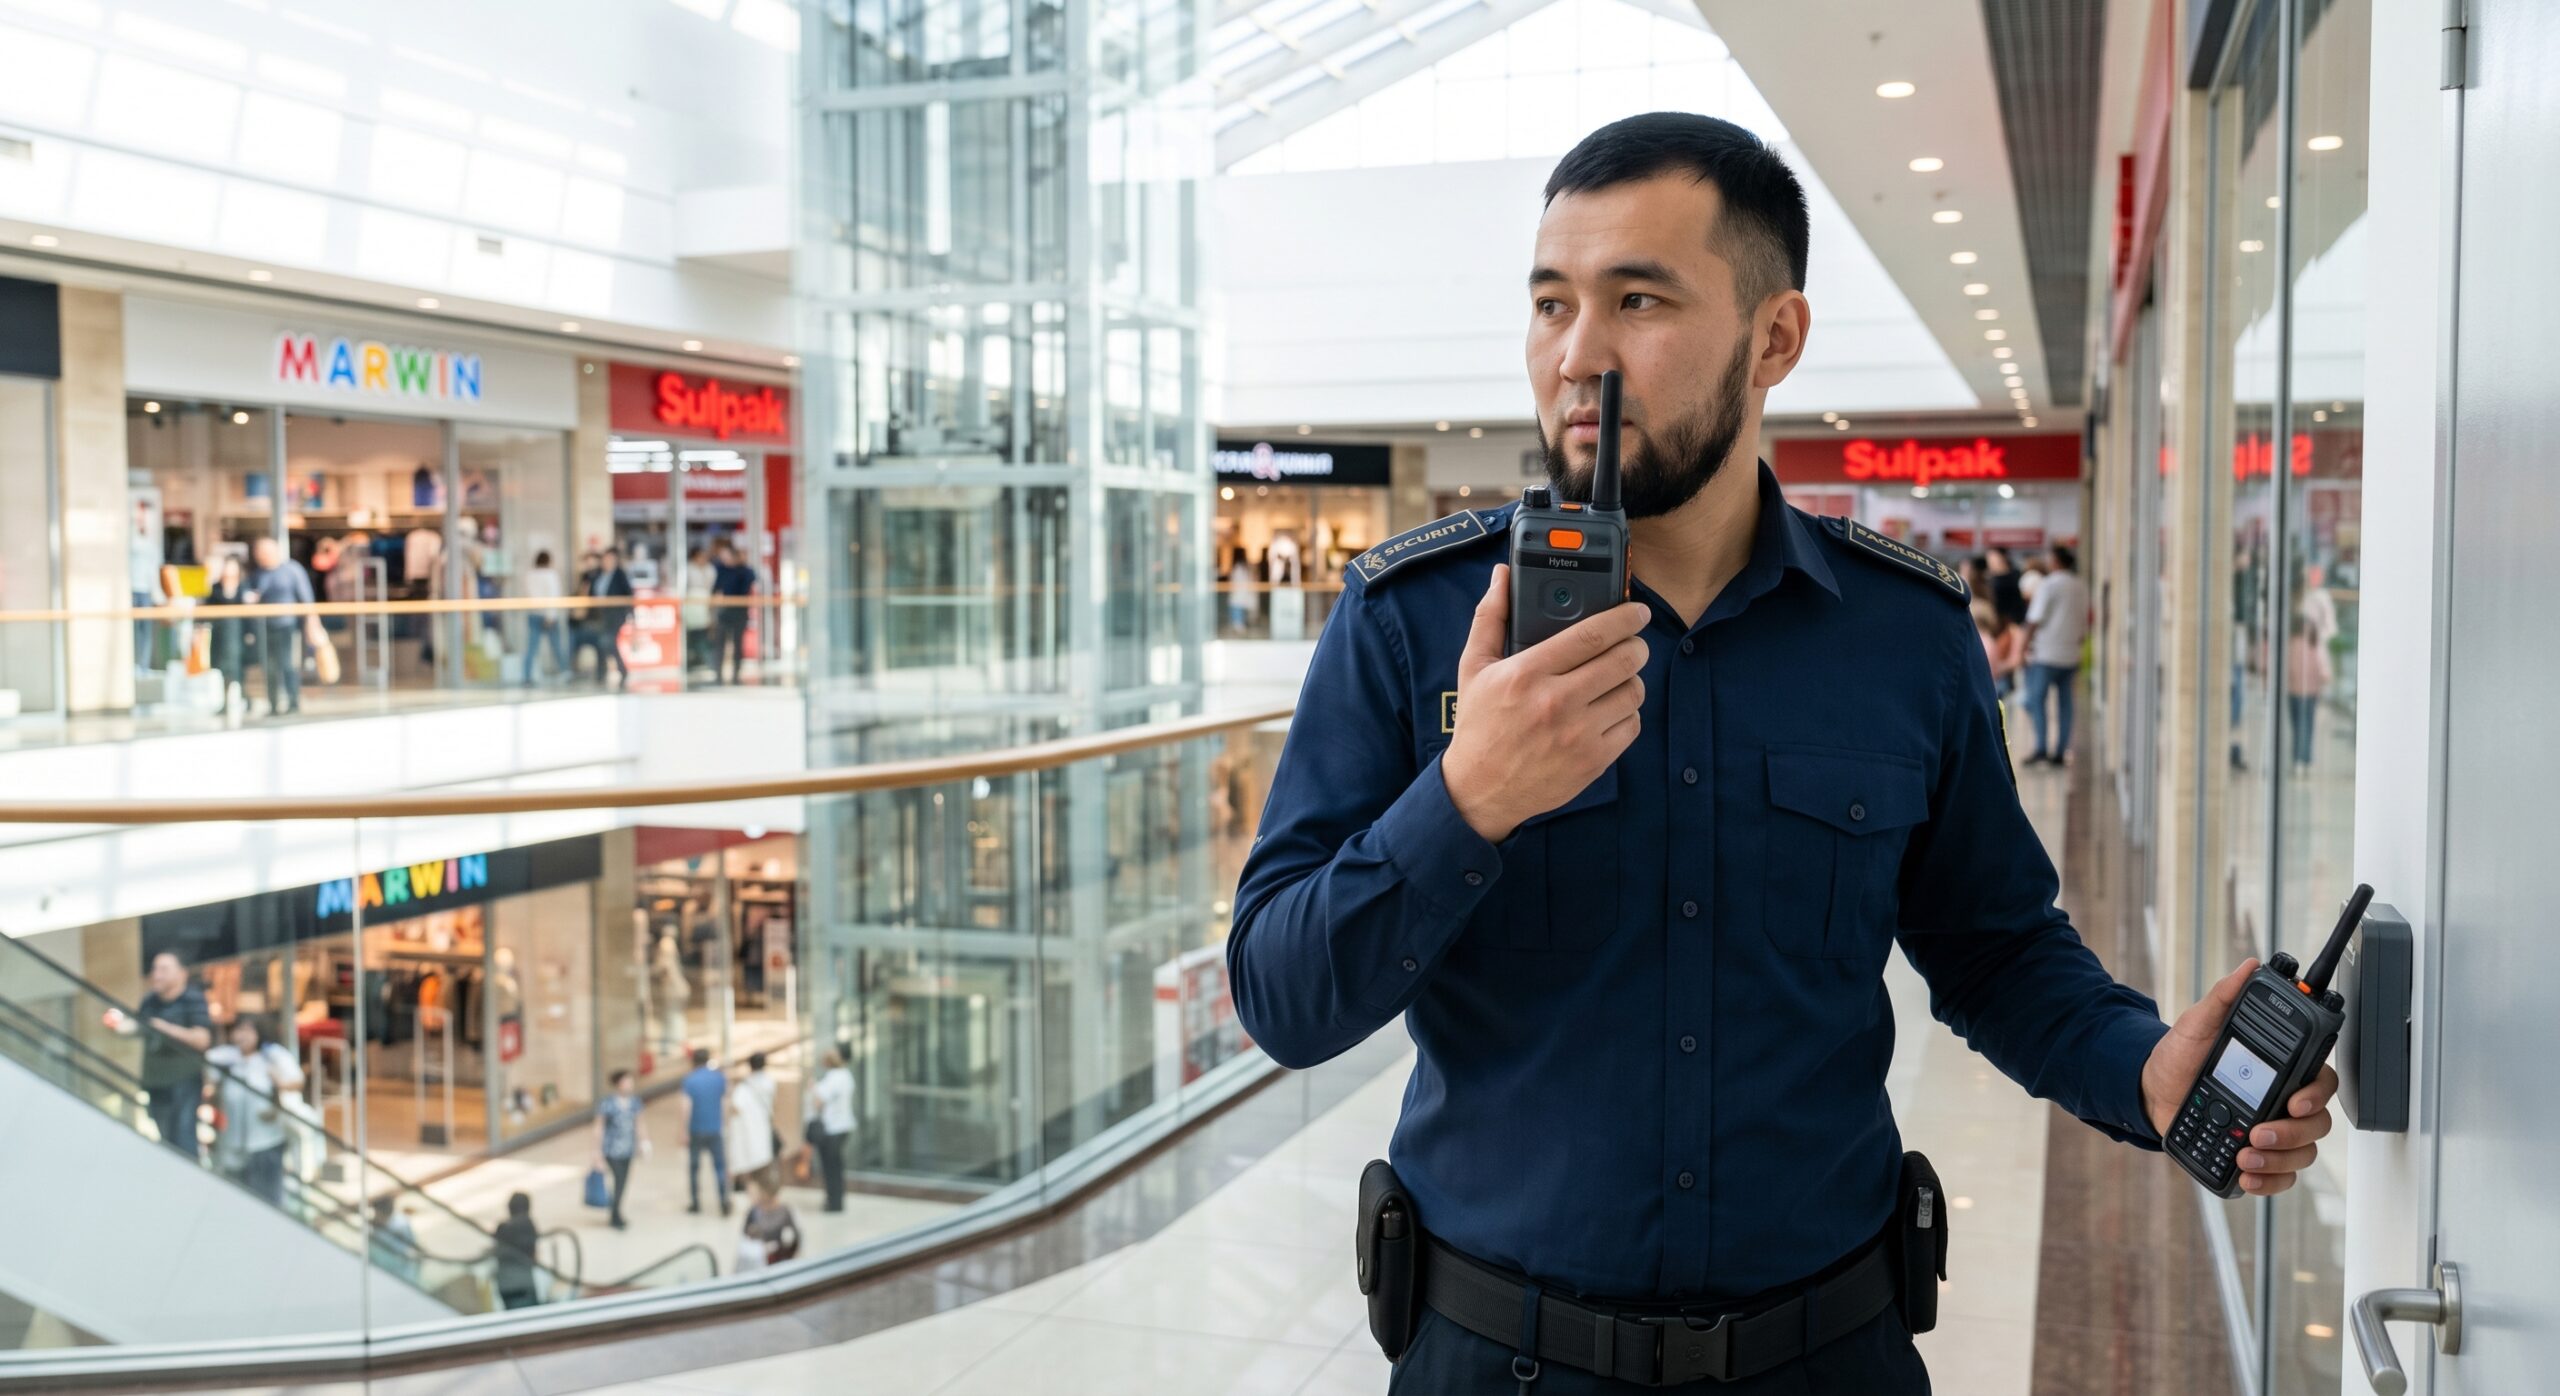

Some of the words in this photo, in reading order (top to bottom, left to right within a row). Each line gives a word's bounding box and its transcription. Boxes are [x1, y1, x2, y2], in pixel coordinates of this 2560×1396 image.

[277, 335, 482, 399] MARWIN
[658, 372, 783, 440] Sulpak
[1843, 436, 2007, 487] Sulpak
[1384, 519, 1470, 557] SECURITY
[1548, 557, 1579, 568] Hytera
[316, 853, 488, 919] MARWIN
